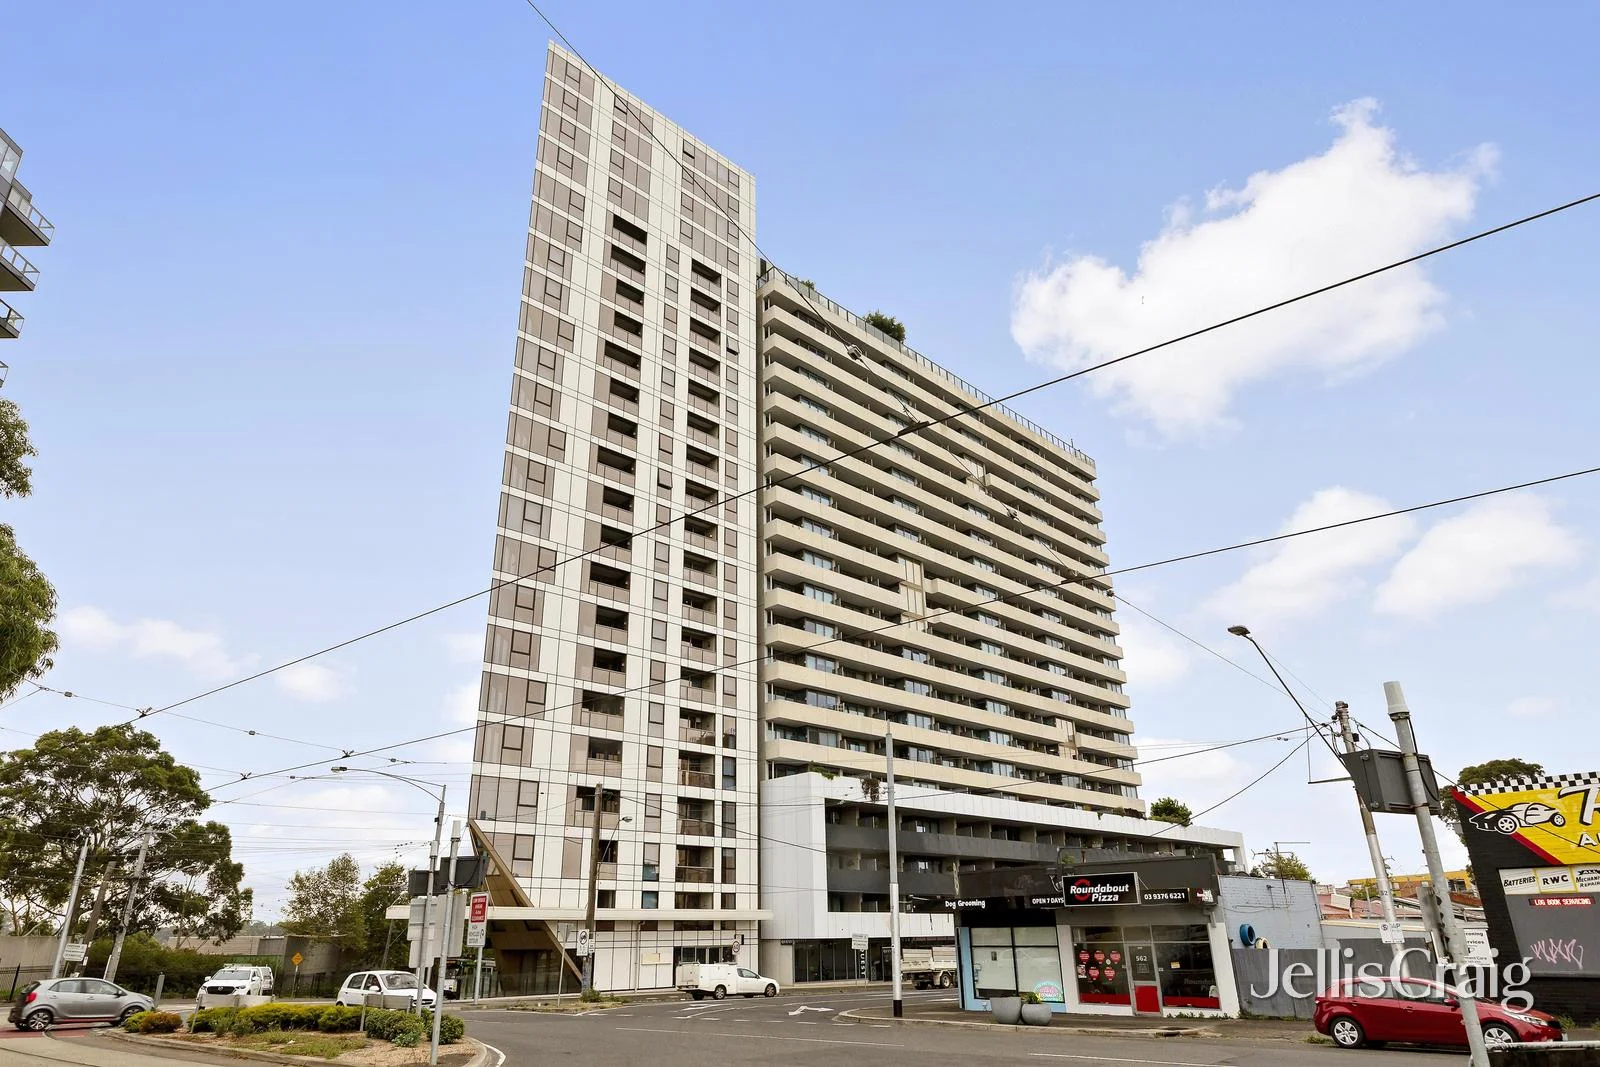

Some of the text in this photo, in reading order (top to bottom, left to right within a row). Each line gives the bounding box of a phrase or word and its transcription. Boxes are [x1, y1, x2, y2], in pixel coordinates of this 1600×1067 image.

[1503, 876, 1536, 887] BATTERIES
[1542, 875, 1569, 886] RWC
[1069, 883, 1130, 895] Roundabout
[1091, 892, 1119, 902] Pizza
[1547, 898, 1561, 906] BOOK
[945, 899, 986, 910] Dog Grooming
